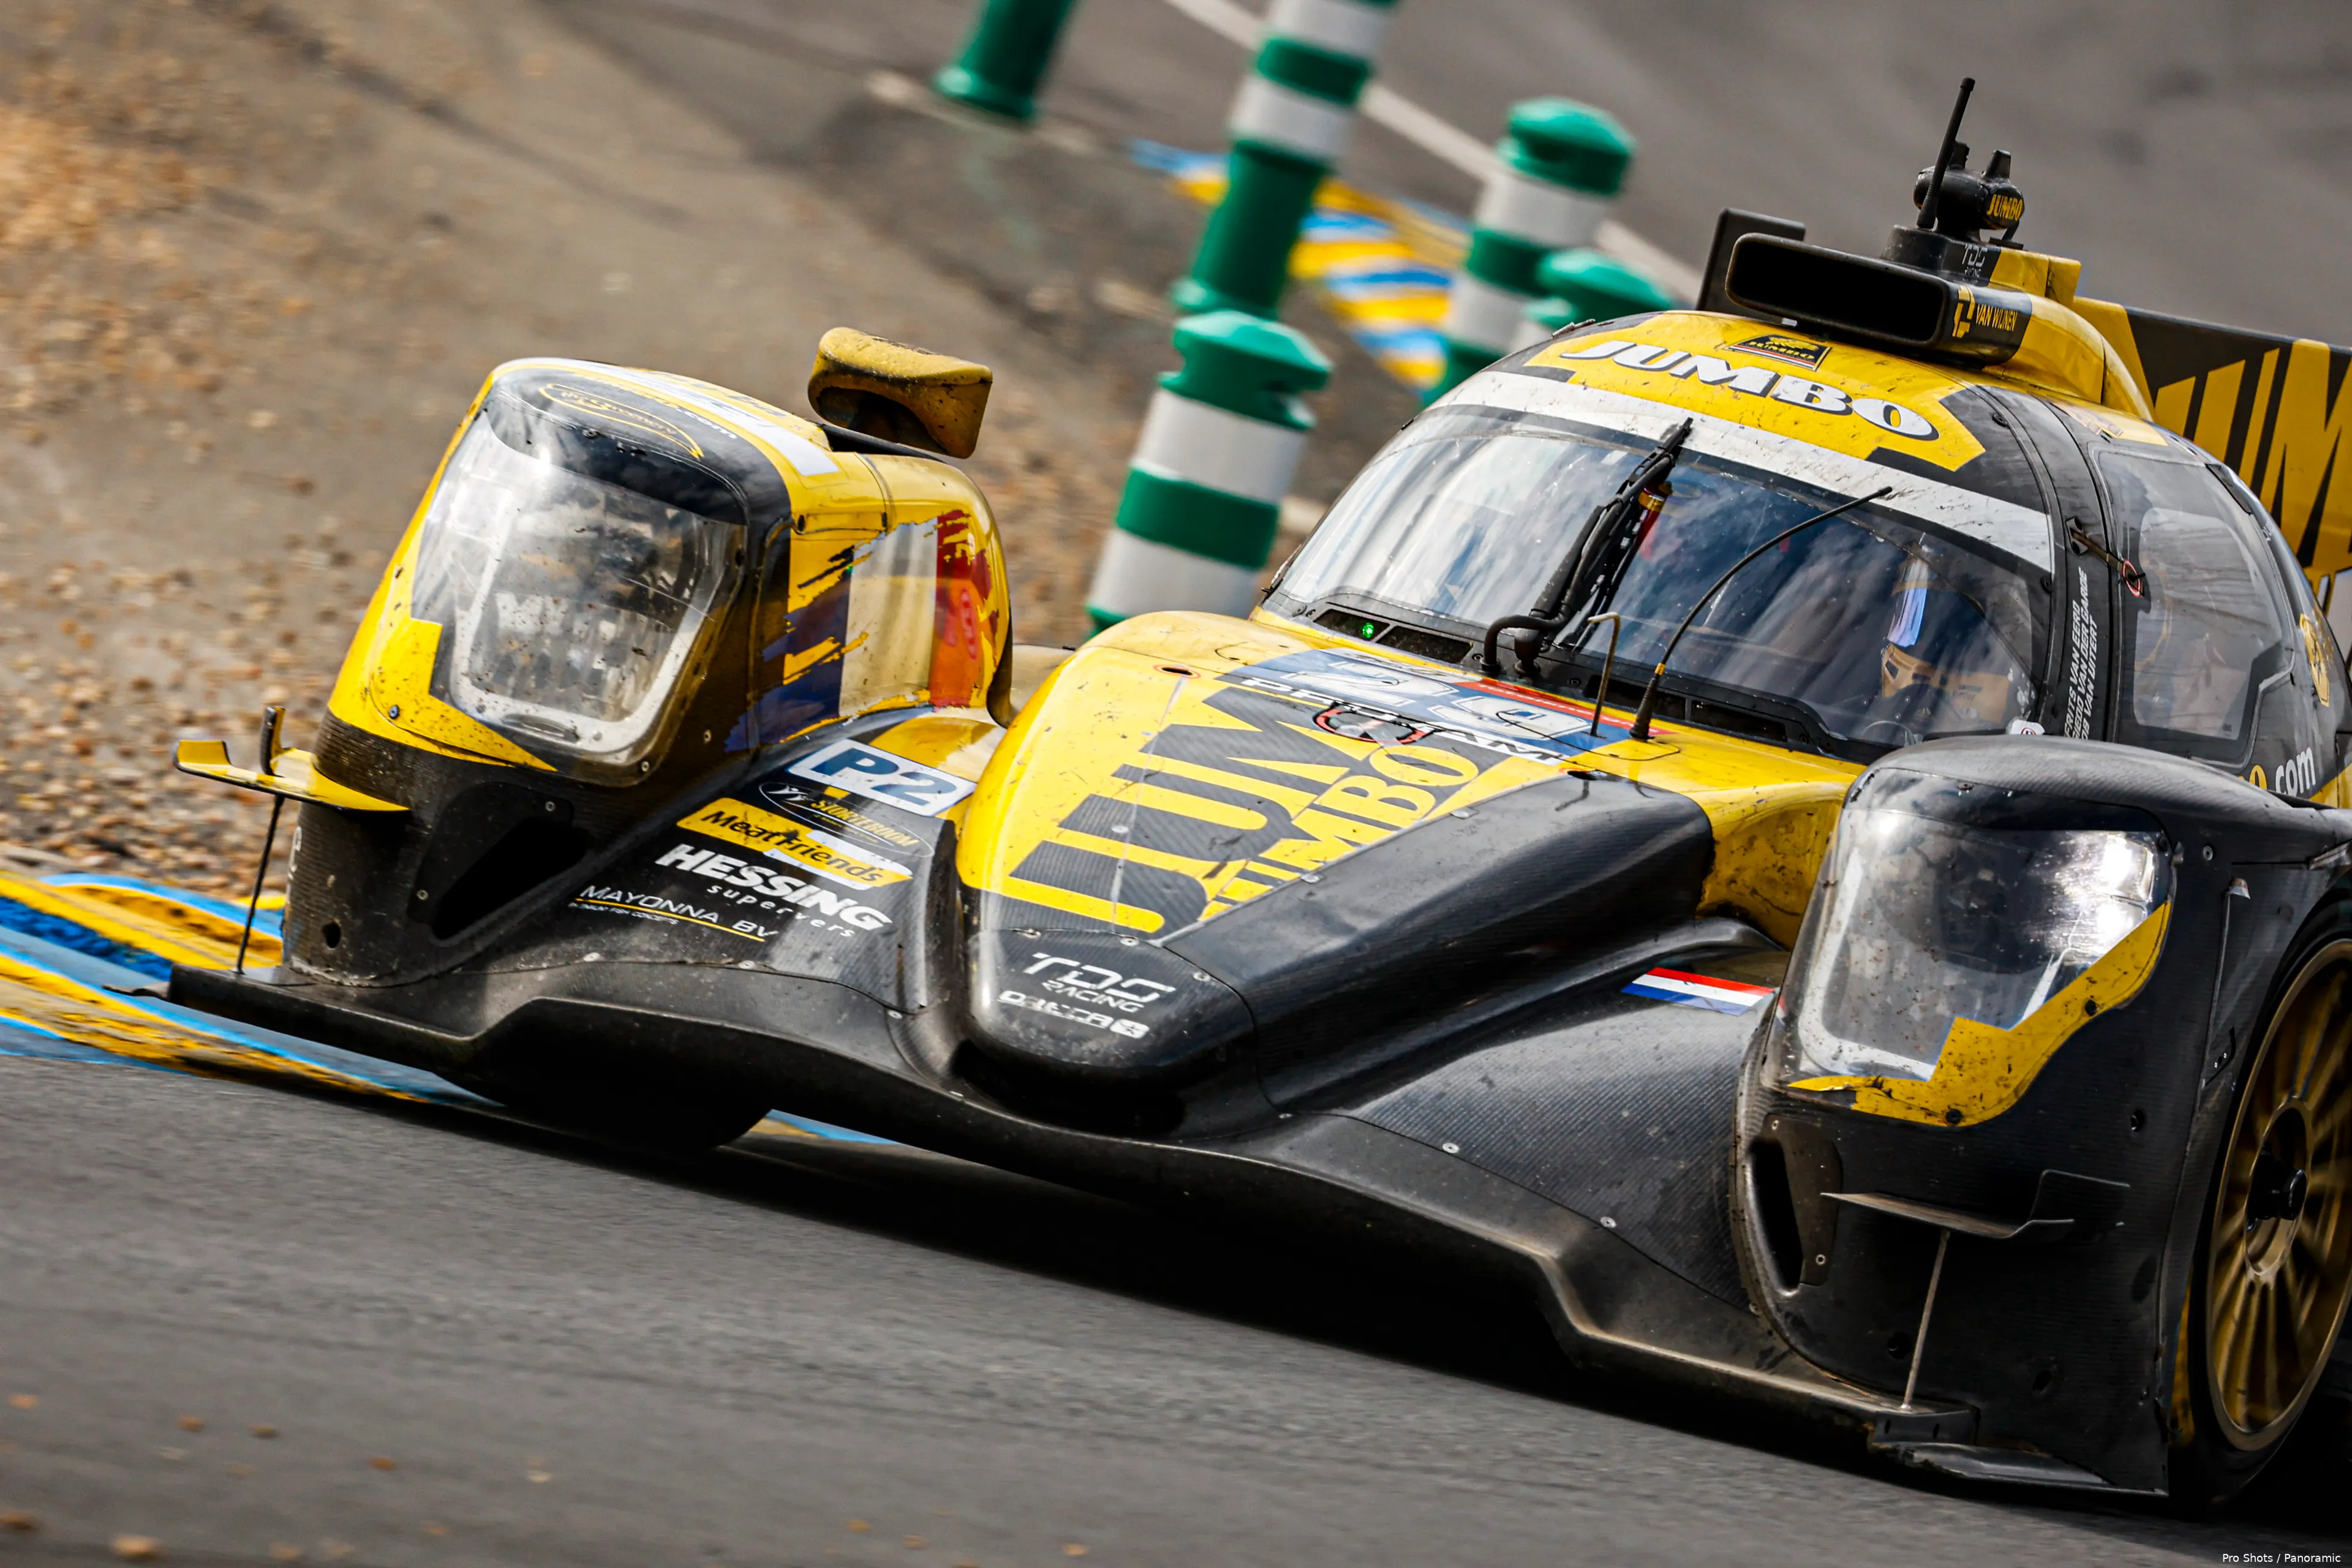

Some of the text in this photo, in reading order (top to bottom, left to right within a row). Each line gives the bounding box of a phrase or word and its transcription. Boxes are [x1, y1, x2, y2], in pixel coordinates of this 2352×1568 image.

[1986, 194, 2023, 221] JUMBO
[1962, 244, 1988, 267] TDS
[1976, 304, 2018, 331] VAN WIJNEN
[1560, 340, 1940, 441] JUMBO
[2078, 566, 2090, 627] GARDE
[2064, 599, 2081, 738] FRITS VAN EERD
[2080, 627, 2090, 660] DER
[2087, 614, 2098, 680] UITERT
[1280, 660, 1594, 741] 29
[2077, 659, 2089, 695] VAN
[2084, 678, 2095, 717] VAN
[810, 747, 957, 806] P2
[580, 885, 780, 938] MAYONNA BV
[655, 843, 892, 930] HESSING
[706, 885, 855, 937] supervers
[1022, 952, 1177, 1003] TDS
[1042, 980, 1145, 1013] RACING
